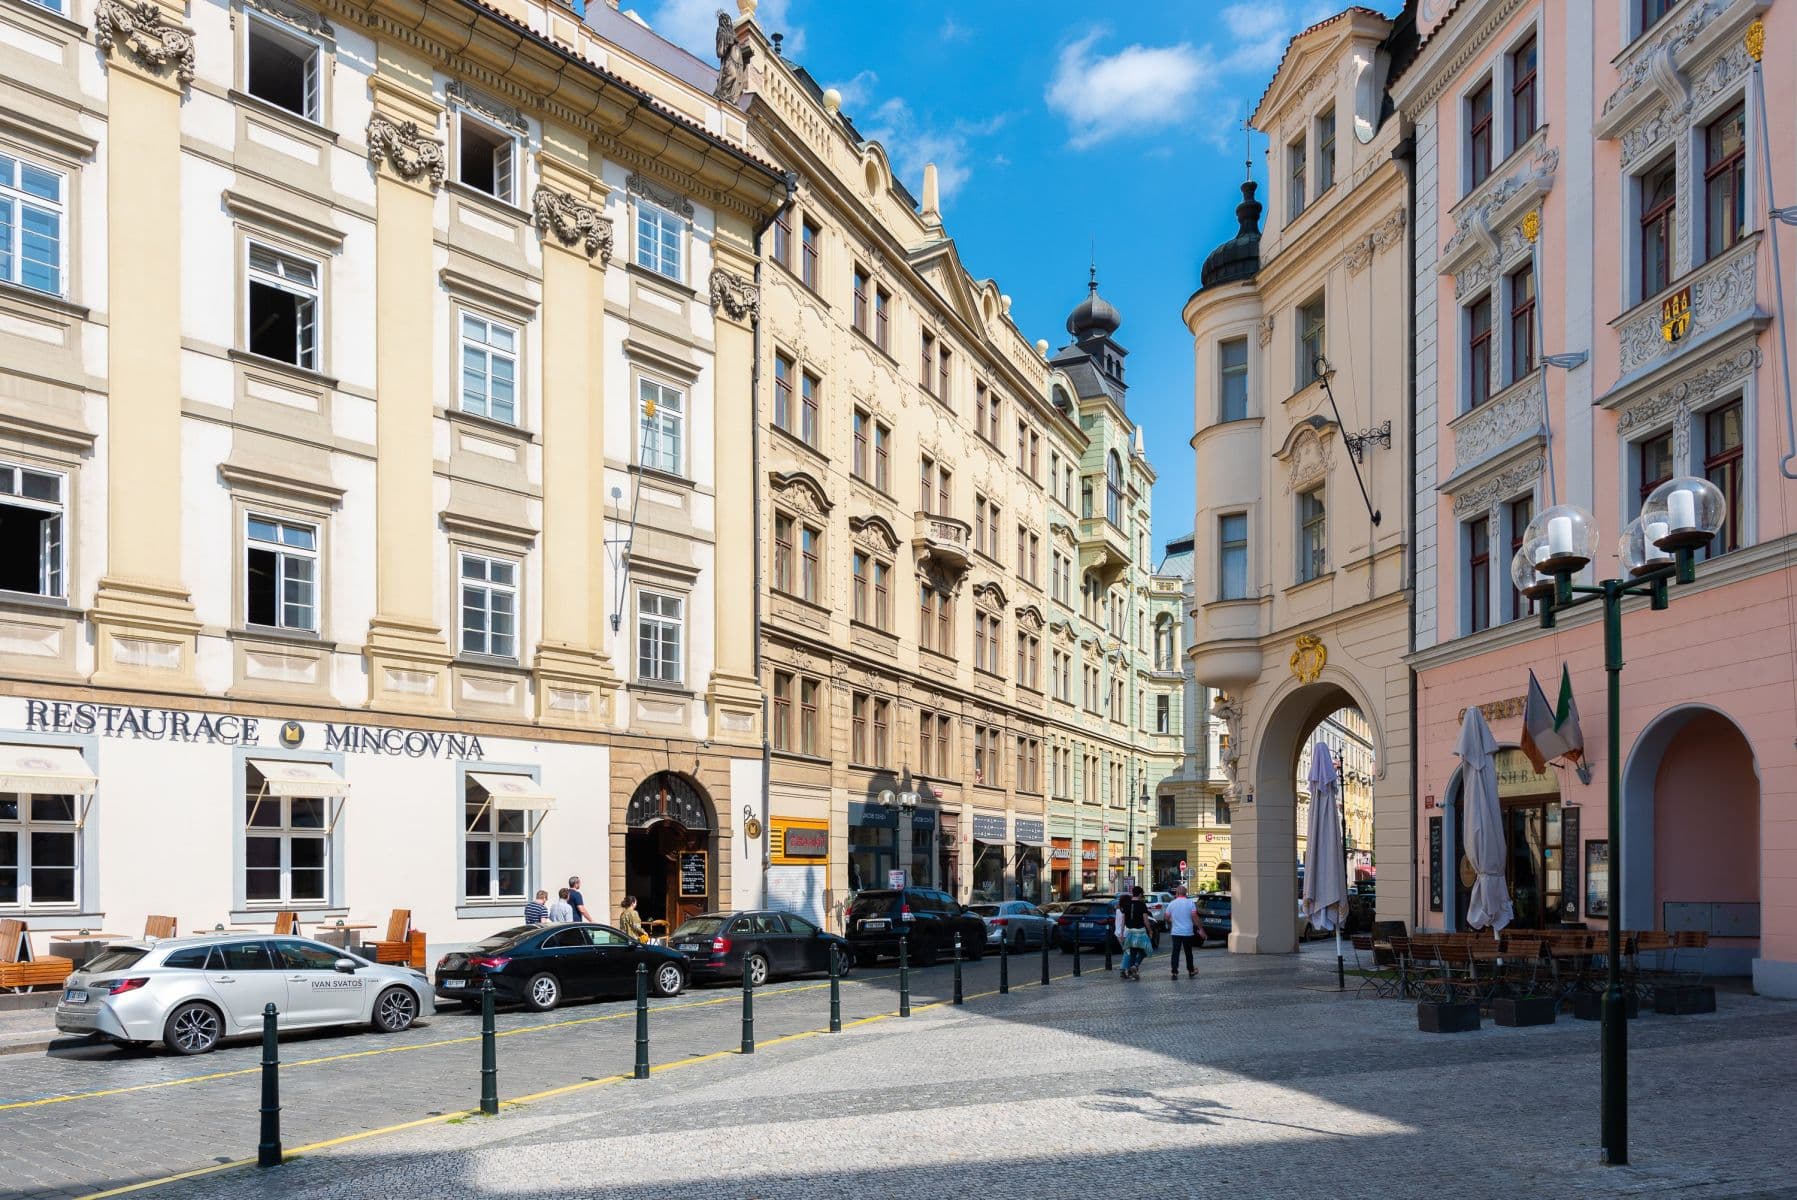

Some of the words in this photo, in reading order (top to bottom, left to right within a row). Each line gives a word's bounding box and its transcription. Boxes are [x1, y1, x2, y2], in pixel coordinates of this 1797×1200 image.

[26, 700, 260, 742] RESTAURACE
[326, 723, 485, 757] MINCOVNA
[333, 979, 362, 987] SVATOŠ
